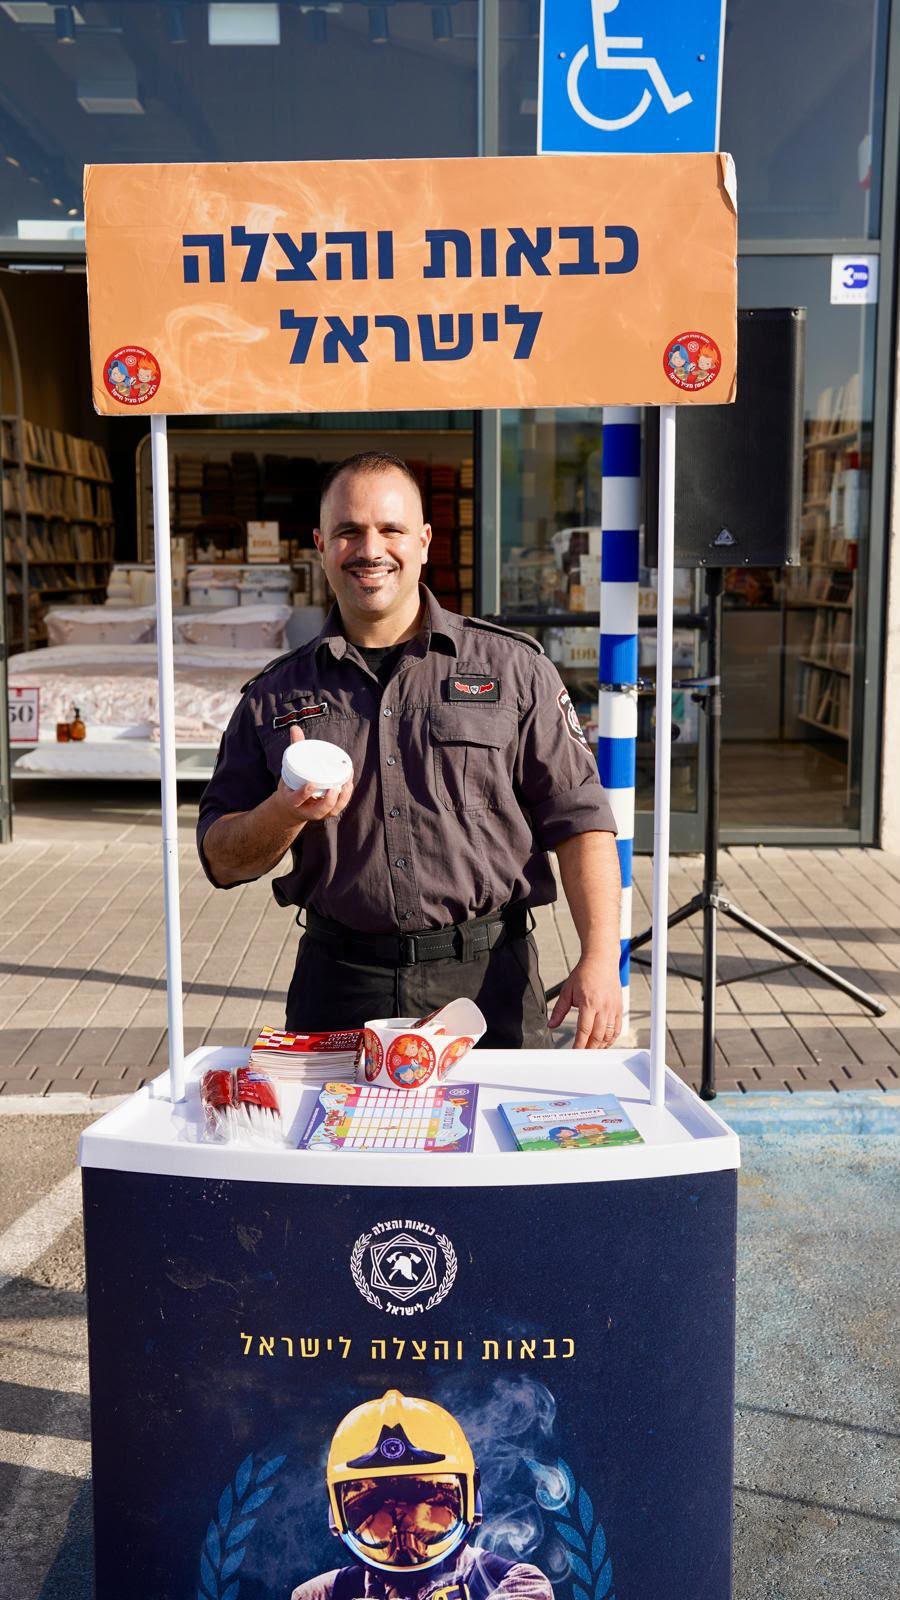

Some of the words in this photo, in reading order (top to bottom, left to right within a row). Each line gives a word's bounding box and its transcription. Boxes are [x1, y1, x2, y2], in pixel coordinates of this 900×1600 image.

[182, 226, 394, 284] והצלה
[422, 225, 640, 279] כבאות
[279, 304, 544, 365] לישראל
[371, 1220, 403, 1236] והצלה
[404, 1219, 436, 1236] כבאות
[385, 1301, 424, 1316] לישראל
[240, 1332, 352, 1359] לישראל
[371, 1336, 464, 1360] והצלה
[481, 1337, 576, 1360] כבאות
